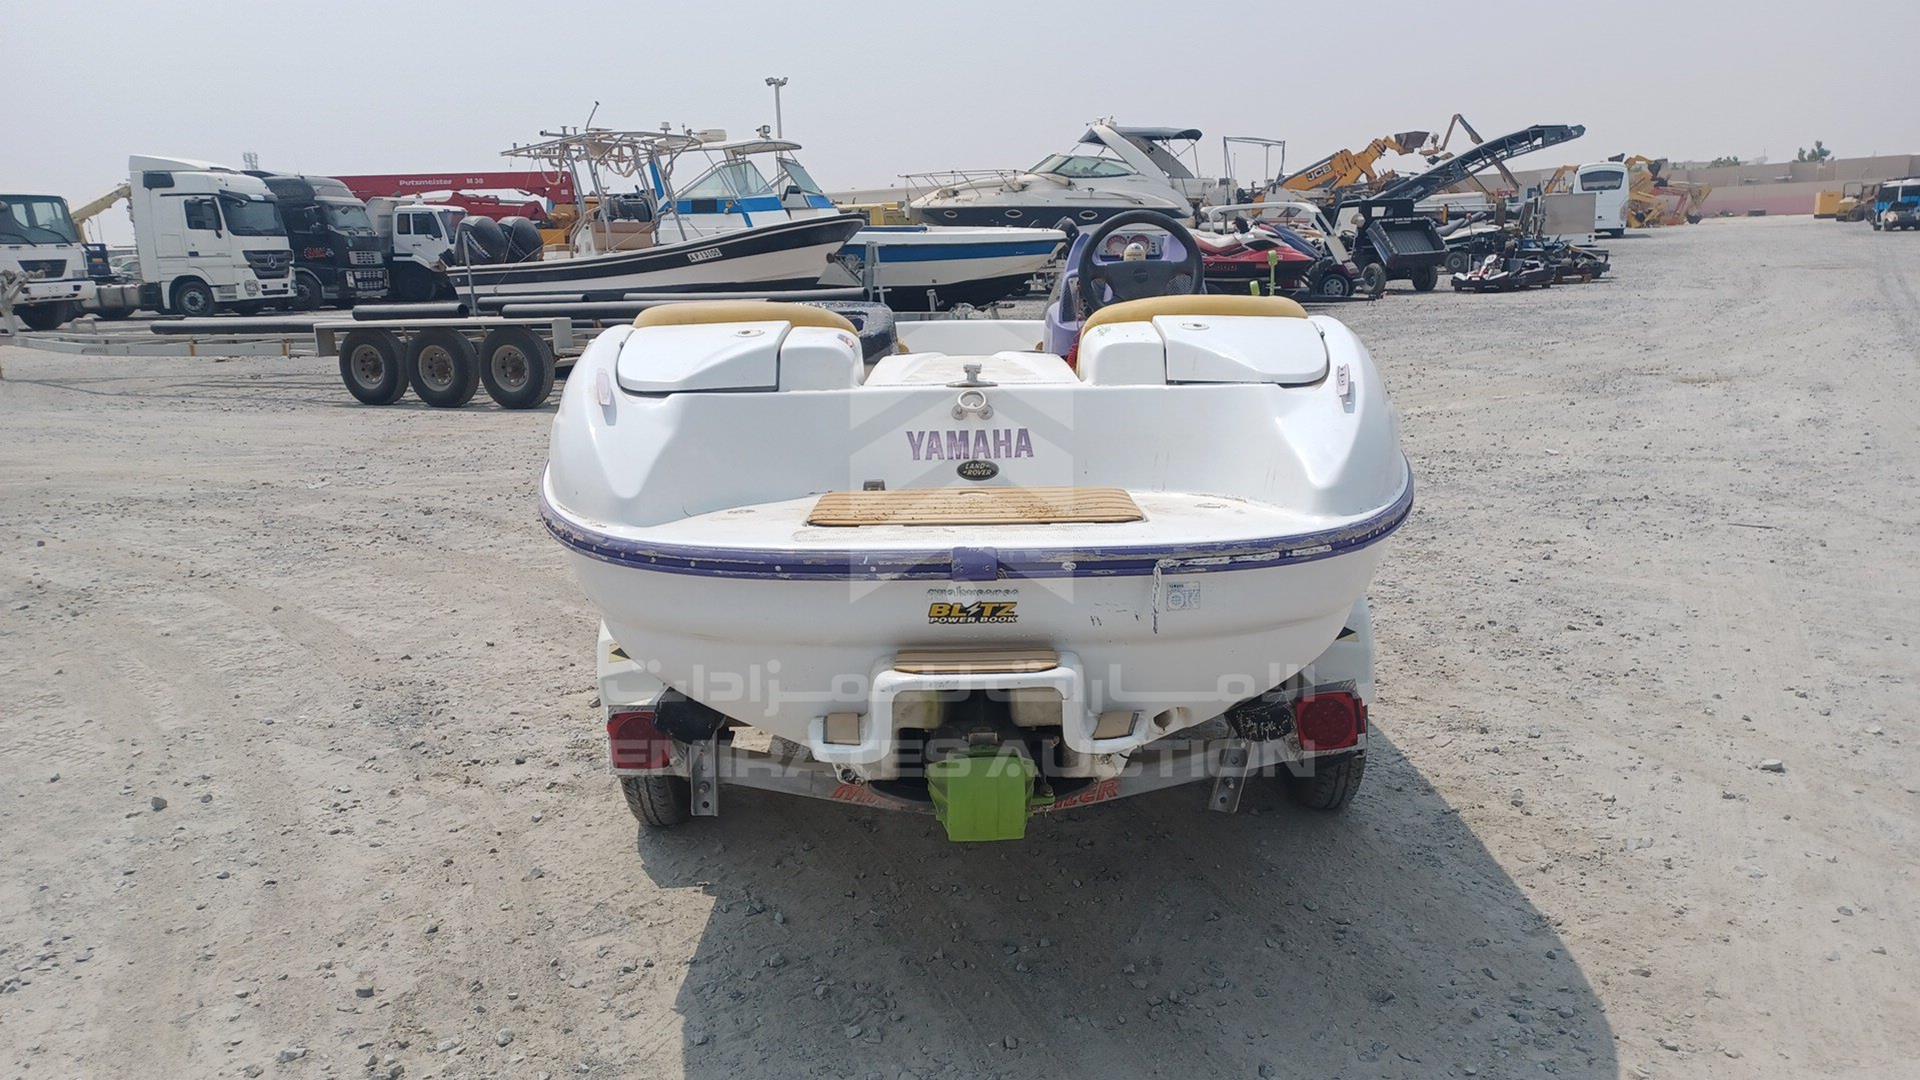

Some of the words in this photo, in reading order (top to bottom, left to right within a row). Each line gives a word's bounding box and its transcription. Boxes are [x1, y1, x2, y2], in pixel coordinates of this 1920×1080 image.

[1307, 164, 1332, 181] JCB
[905, 427, 1035, 461] YAMAHA
[965, 462, 987, 470] LAND
[966, 469, 992, 477] ROVER
[928, 601, 1018, 617] BLITZ
[929, 615, 976, 624] POWER
[980, 614, 1018, 623] BOOK
